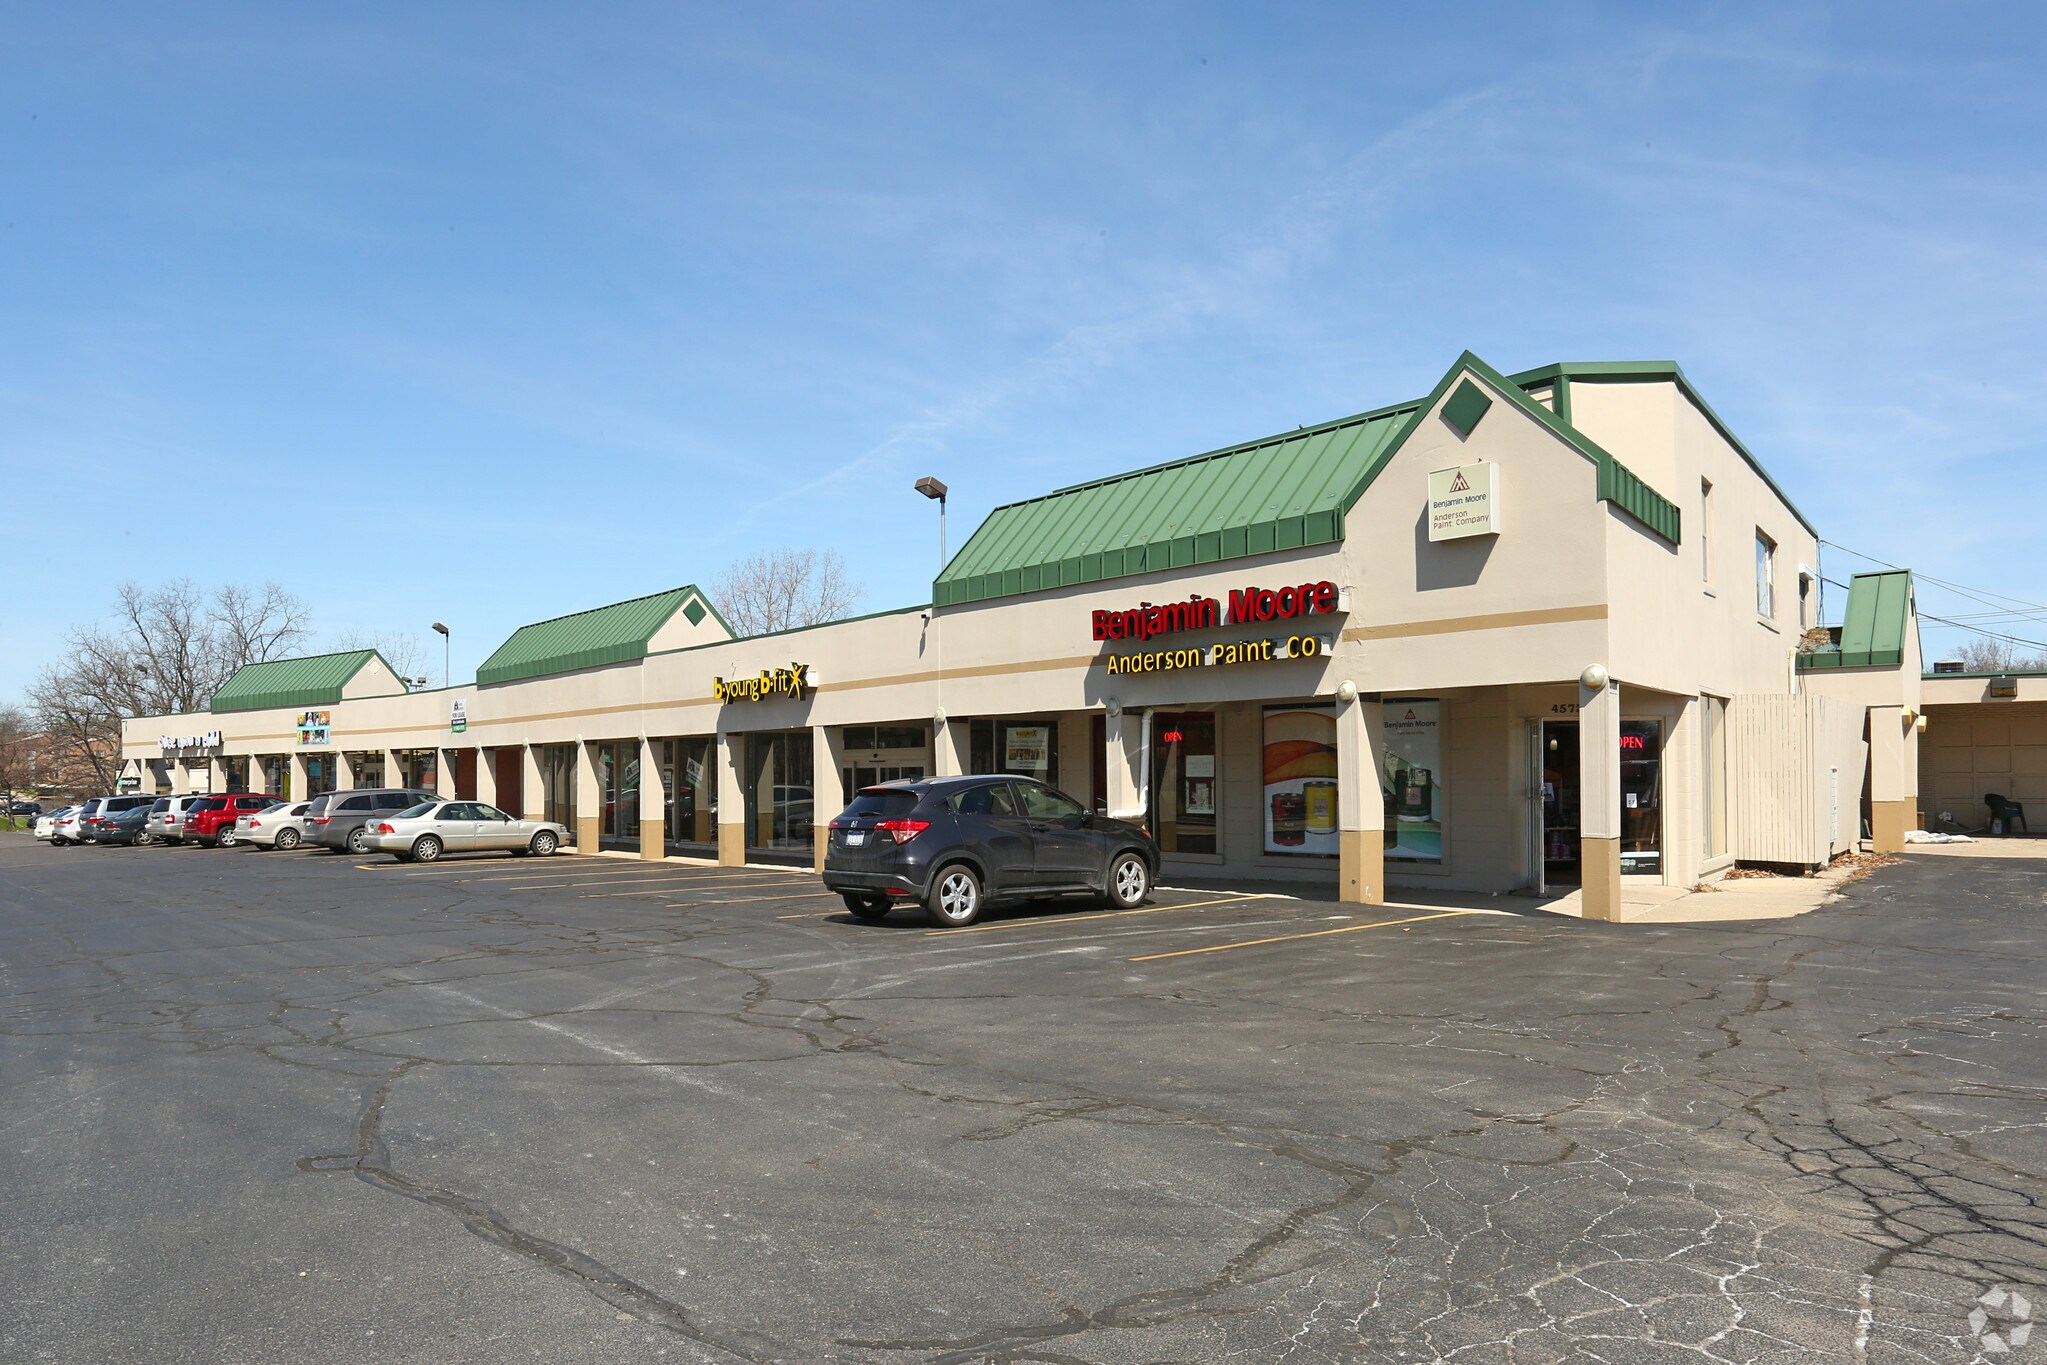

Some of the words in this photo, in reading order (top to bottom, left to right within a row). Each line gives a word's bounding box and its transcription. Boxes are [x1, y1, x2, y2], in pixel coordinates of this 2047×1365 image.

[1433, 498, 1463, 509] Benjamin
[1465, 493, 1487, 503] Moore
[1433, 520, 1452, 529] Paint
[1456, 514, 1489, 526] Company
[1434, 510, 1468, 522] Anderson
[1092, 594, 1217, 641] Benjamin
[1229, 580, 1336, 624] Moore
[1107, 648, 1200, 675] Anderson
[1213, 638, 1272, 666] Paint
[1287, 635, 1316, 659] Co
[1384, 720, 1414, 729] Benjamin
[1164, 732, 1183, 742] OPEN
